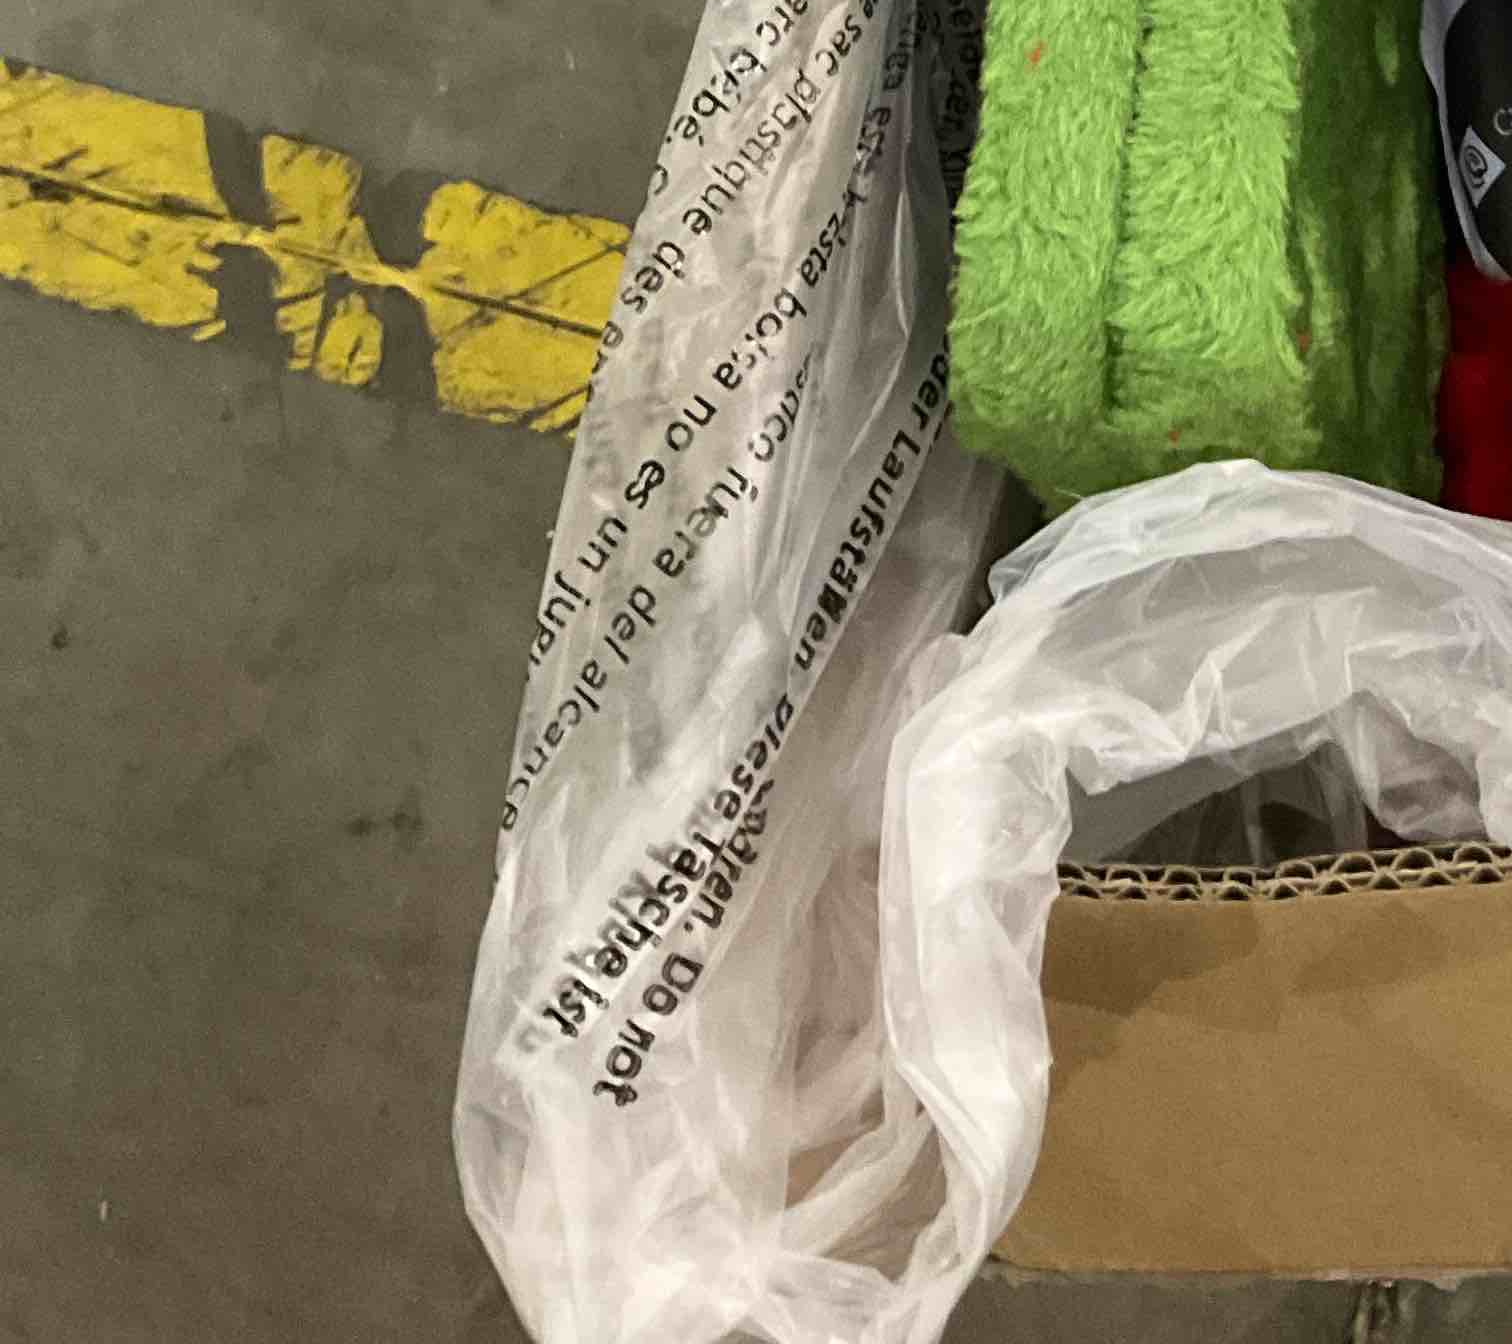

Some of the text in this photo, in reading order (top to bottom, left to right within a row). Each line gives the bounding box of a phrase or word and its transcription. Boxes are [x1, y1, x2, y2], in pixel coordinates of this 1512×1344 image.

[809, 13, 868, 77] sac
[676, 70, 827, 239] plastique
[616, 236, 697, 317] des
[657, 391, 723, 456] no
[618, 455, 672, 513] es
[577, 512, 630, 574] un
[596, 583, 668, 666] del
[634, 944, 706, 1026] Do
[587, 1018, 658, 1113] not
